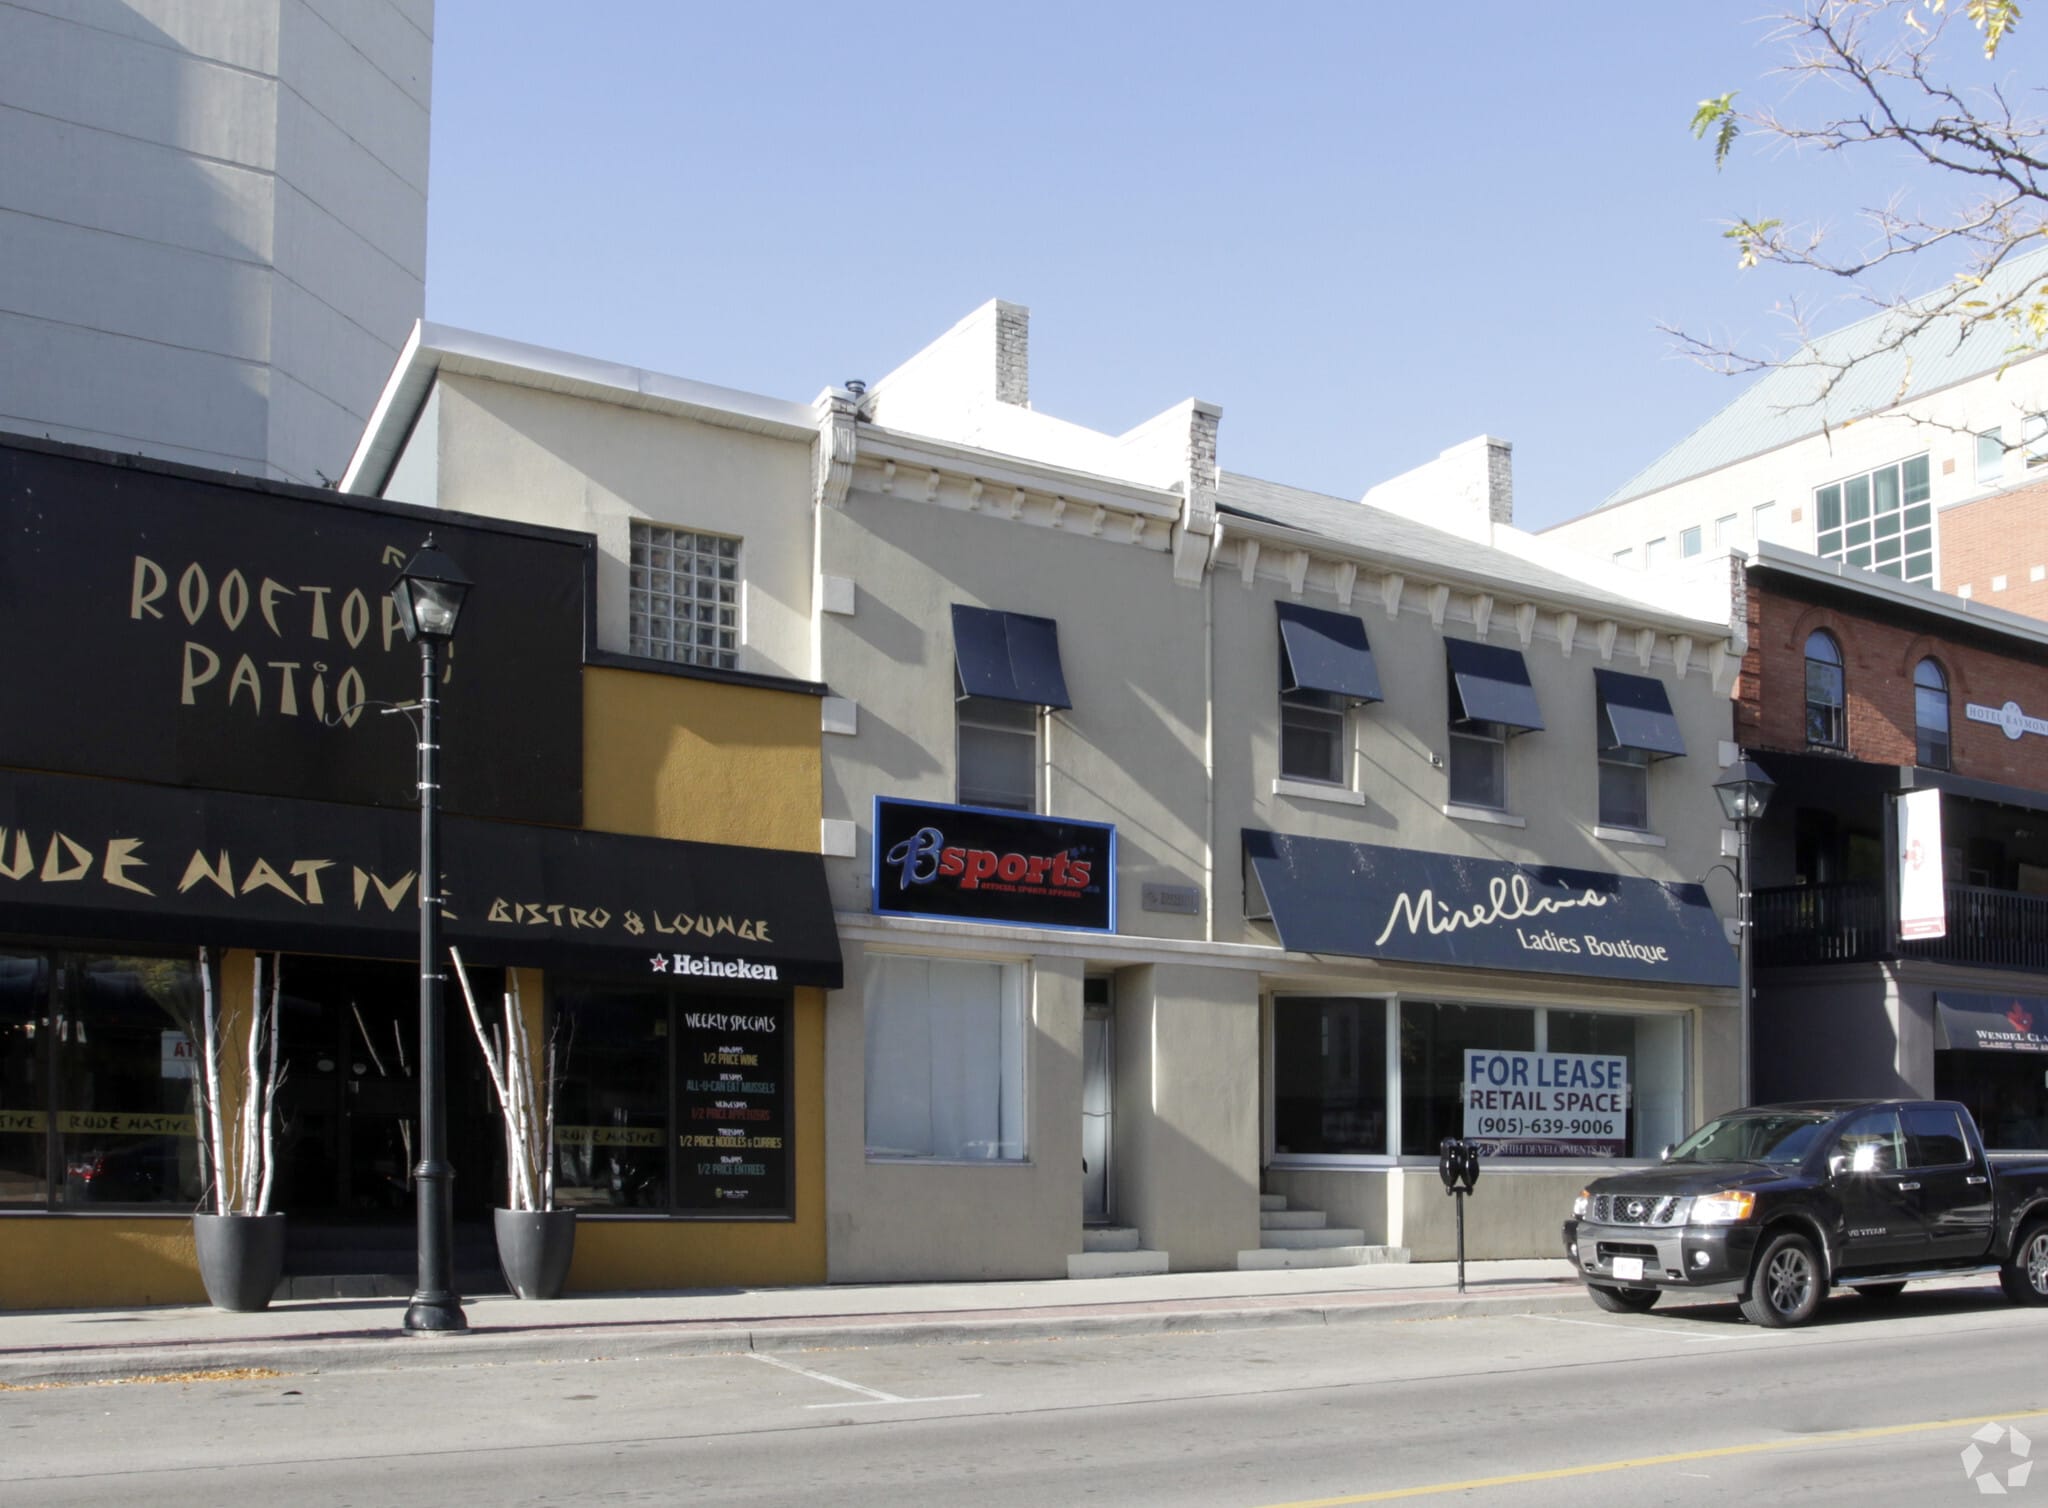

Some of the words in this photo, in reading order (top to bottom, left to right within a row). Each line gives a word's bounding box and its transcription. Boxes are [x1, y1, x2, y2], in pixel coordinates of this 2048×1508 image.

[1969, 706, 2001, 723] HOTEL
[2005, 713, 2048, 732] RAYMON
[0, 826, 156, 896] UDE
[487, 897, 610, 929] BISTRO
[623, 910, 646, 935] &
[655, 910, 773, 943] LOUNGE
[1516, 928, 1581, 954] Ladies
[1584, 935, 1669, 964] Boutique
[673, 953, 778, 981] Heineken
[685, 1012, 728, 1031] WEEKLY
[1976, 1029, 2025, 1041] WENDEL
[2027, 1033, 2048, 1042] CLA
[174, 1041, 193, 1057] AT
[703, 1052, 716, 1065] 1/2
[718, 1053, 739, 1066] PRICE
[740, 1054, 759, 1067] WINE
[1470, 1055, 1529, 1087] FOR
[1537, 1058, 1623, 1090] LEASE
[1469, 1089, 1548, 1112] RETAIL
[1552, 1092, 1622, 1114] SPACE
[0, 1114, 35, 1129] TIVE
[70, 1115, 121, 1131] RUDE
[127, 1117, 192, 1133] NATIVE
[1477, 1117, 1614, 1136] (905)-639-9006
[680, 1135, 692, 1148] 1/2
[697, 1163, 711, 1175] 1/2
